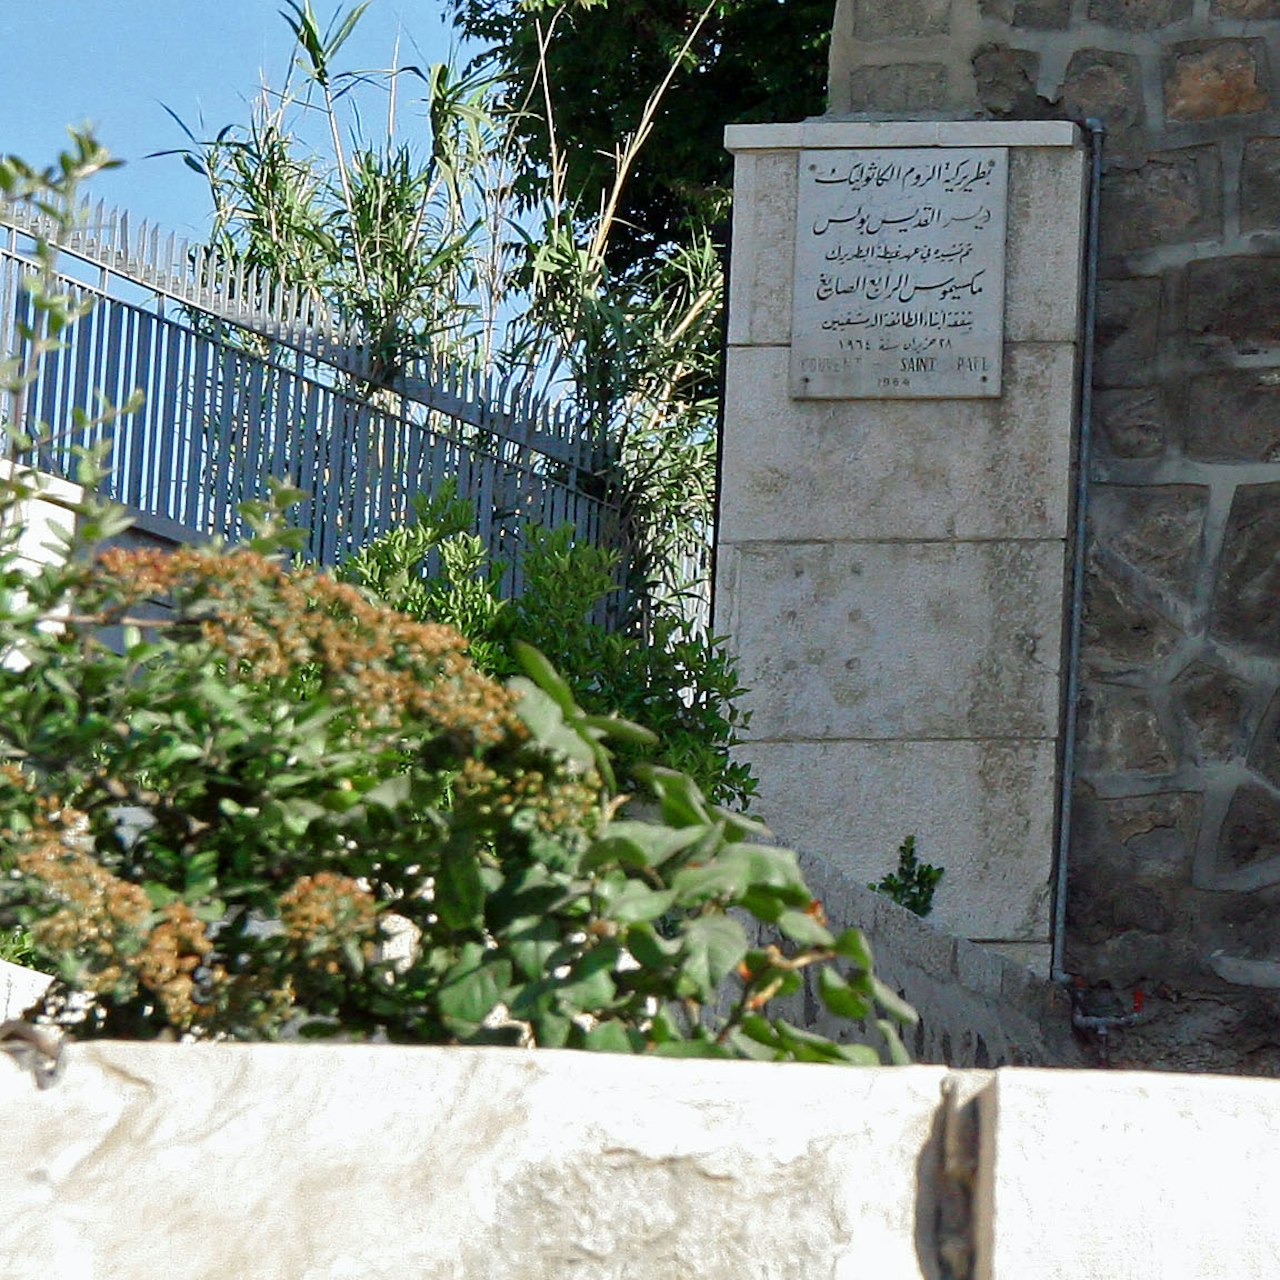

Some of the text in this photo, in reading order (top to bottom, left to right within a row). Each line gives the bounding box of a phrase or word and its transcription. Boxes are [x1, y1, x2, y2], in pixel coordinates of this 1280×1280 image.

[815, 158, 992, 192] بطريركية الروم الكاثوليك
[813, 206, 991, 235] دير القديس بولس
[825, 245, 874, 265] البطريرك
[877, 245, 902, 264] غبطة
[898, 247, 919, 262] عهد
[921, 245, 932, 263] في
[960, 243, 973, 264] تم
[866, 274, 909, 300] الرابع
[902, 338, 937, 354] حزيران
[900, 357, 937, 372] SAINT
[957, 356, 989, 372] PAUL
